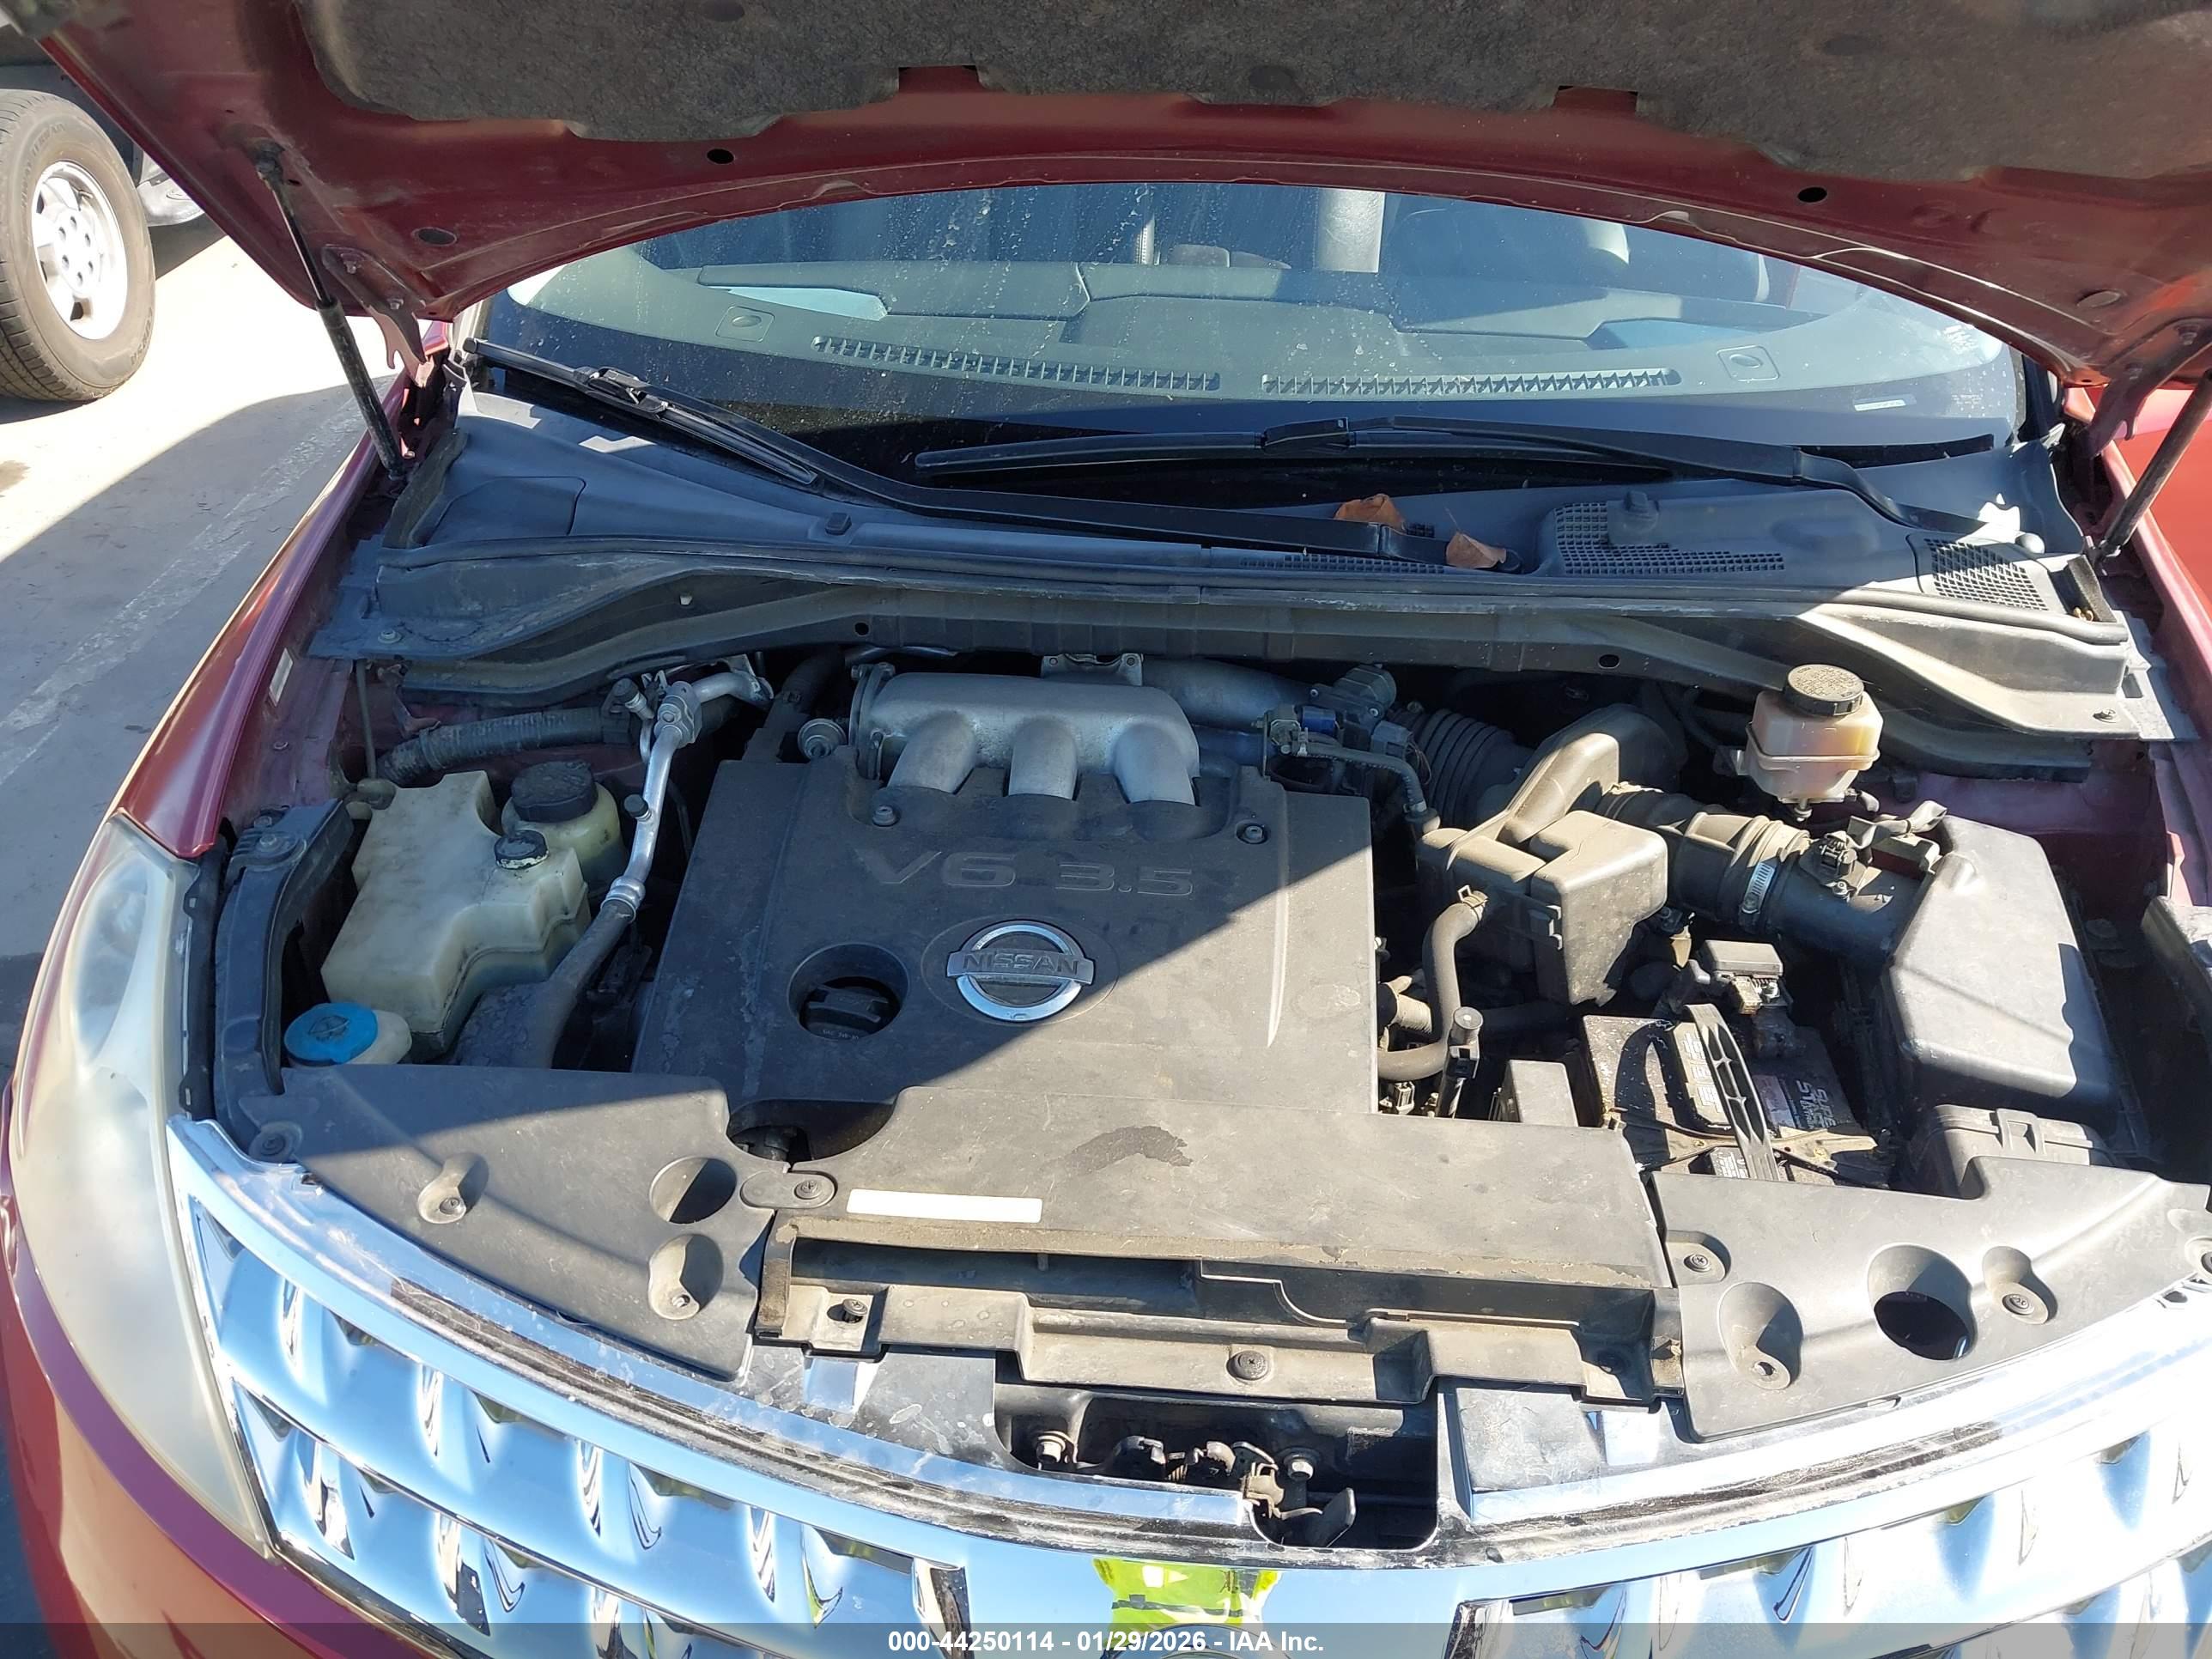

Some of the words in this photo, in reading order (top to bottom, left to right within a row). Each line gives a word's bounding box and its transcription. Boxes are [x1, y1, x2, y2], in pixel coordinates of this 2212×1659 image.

[856, 849, 1017, 888] V6
[1055, 862, 1194, 896] 3.5
[962, 951, 1079, 976] NISSAN
